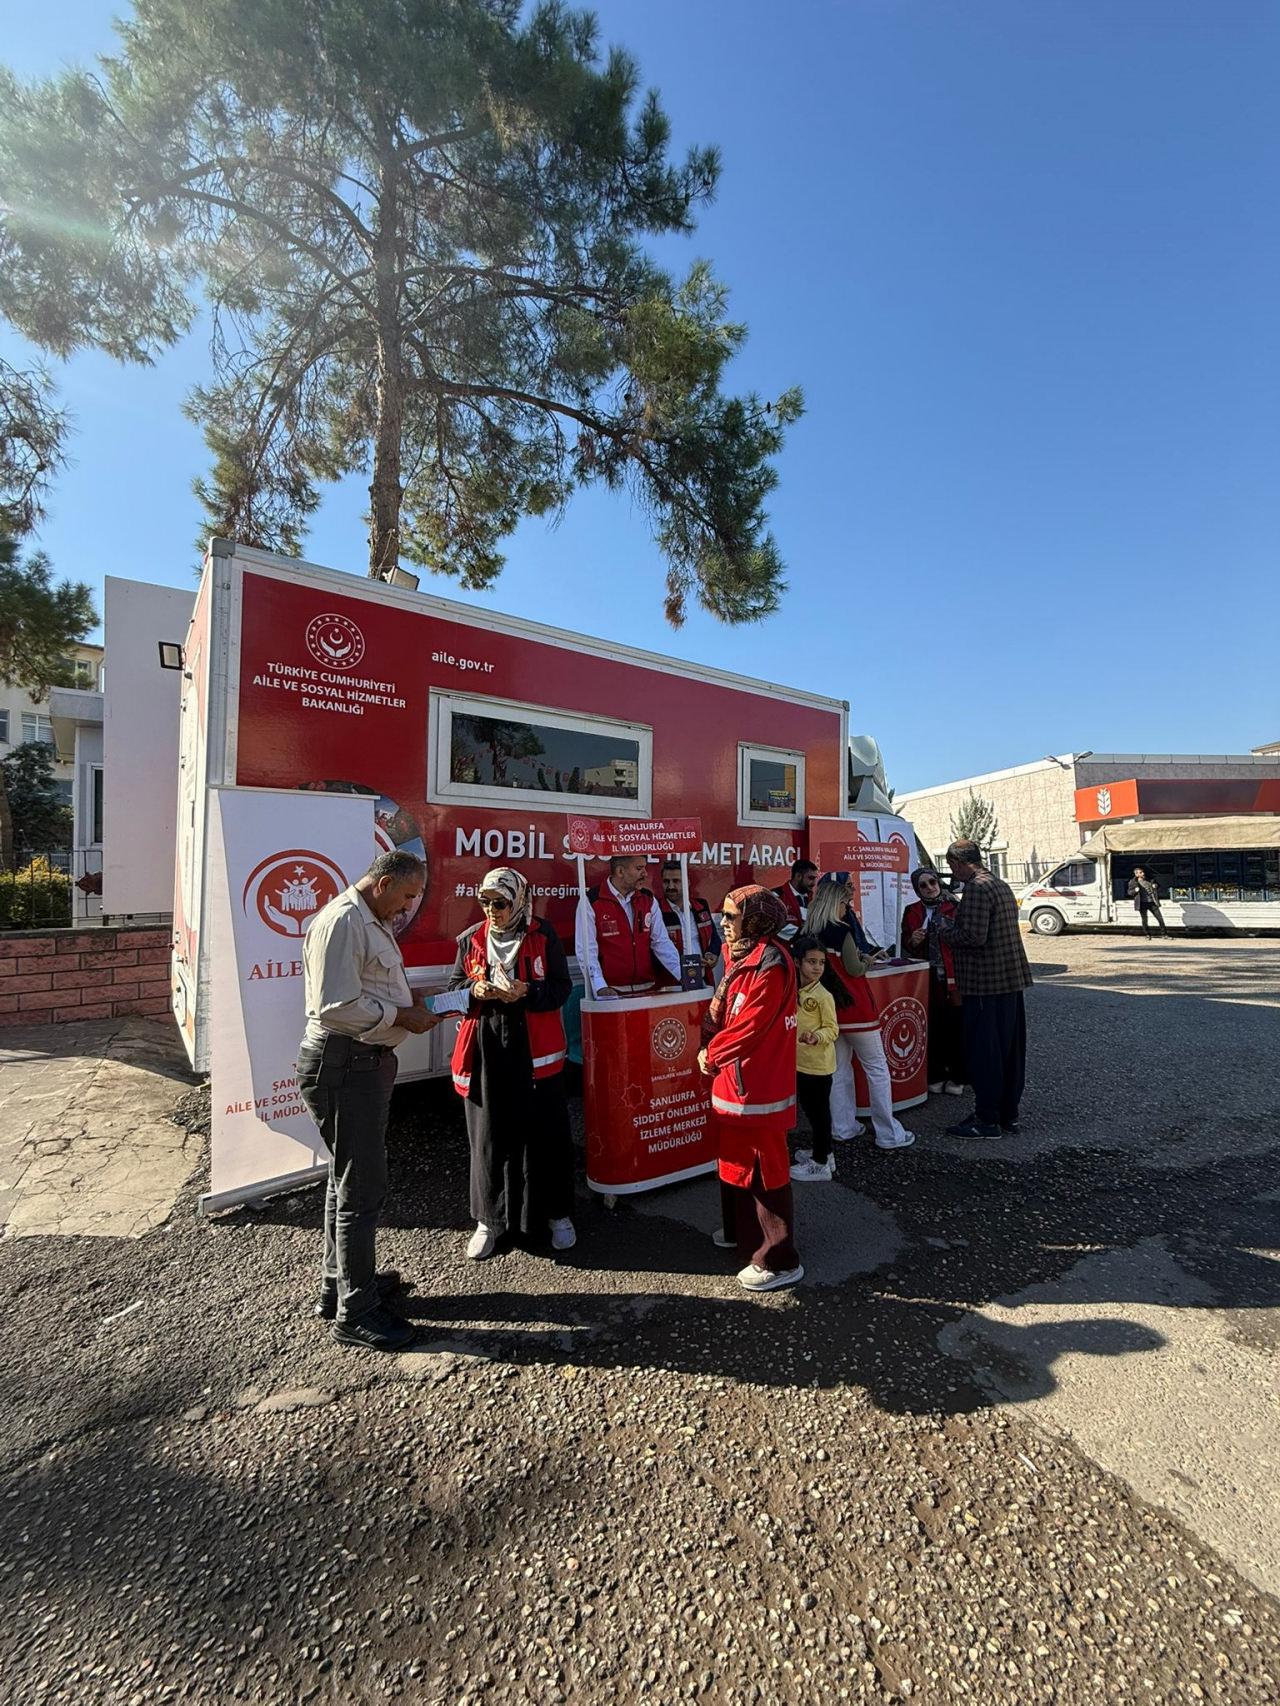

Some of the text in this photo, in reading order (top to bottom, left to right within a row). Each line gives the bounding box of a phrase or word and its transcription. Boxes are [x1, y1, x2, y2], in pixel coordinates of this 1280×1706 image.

[432, 650, 495, 673] aile.gov.tr
[267, 662, 396, 694] TÜRKİYE CUMHURİYETİ
[253, 674, 406, 709] AİLE VE SOSYAL HİZMETLER
[302, 697, 364, 715] BAKANLIĞI
[592, 831, 697, 842] AİLE VE SOSYAL HİZMETLER
[618, 822, 665, 832] ŞANLIURFA
[455, 824, 555, 860] MOBİL
[612, 841, 675, 853] İL MÜDÜRLÜĞÜ
[247, 959, 304, 981] AİLE
[225, 1092, 302, 1115] AİLE VE SOSY
[650, 1090, 696, 1109] ŞANLIURFA
[260, 1111, 271, 1122] İL
[632, 1100, 710, 1128] ŞİDDET ÖNLEME VE
[640, 1114, 707, 1140] İZLEME MERKEZİ
[648, 1131, 702, 1153] MÜDÜRLÜĞÜ
